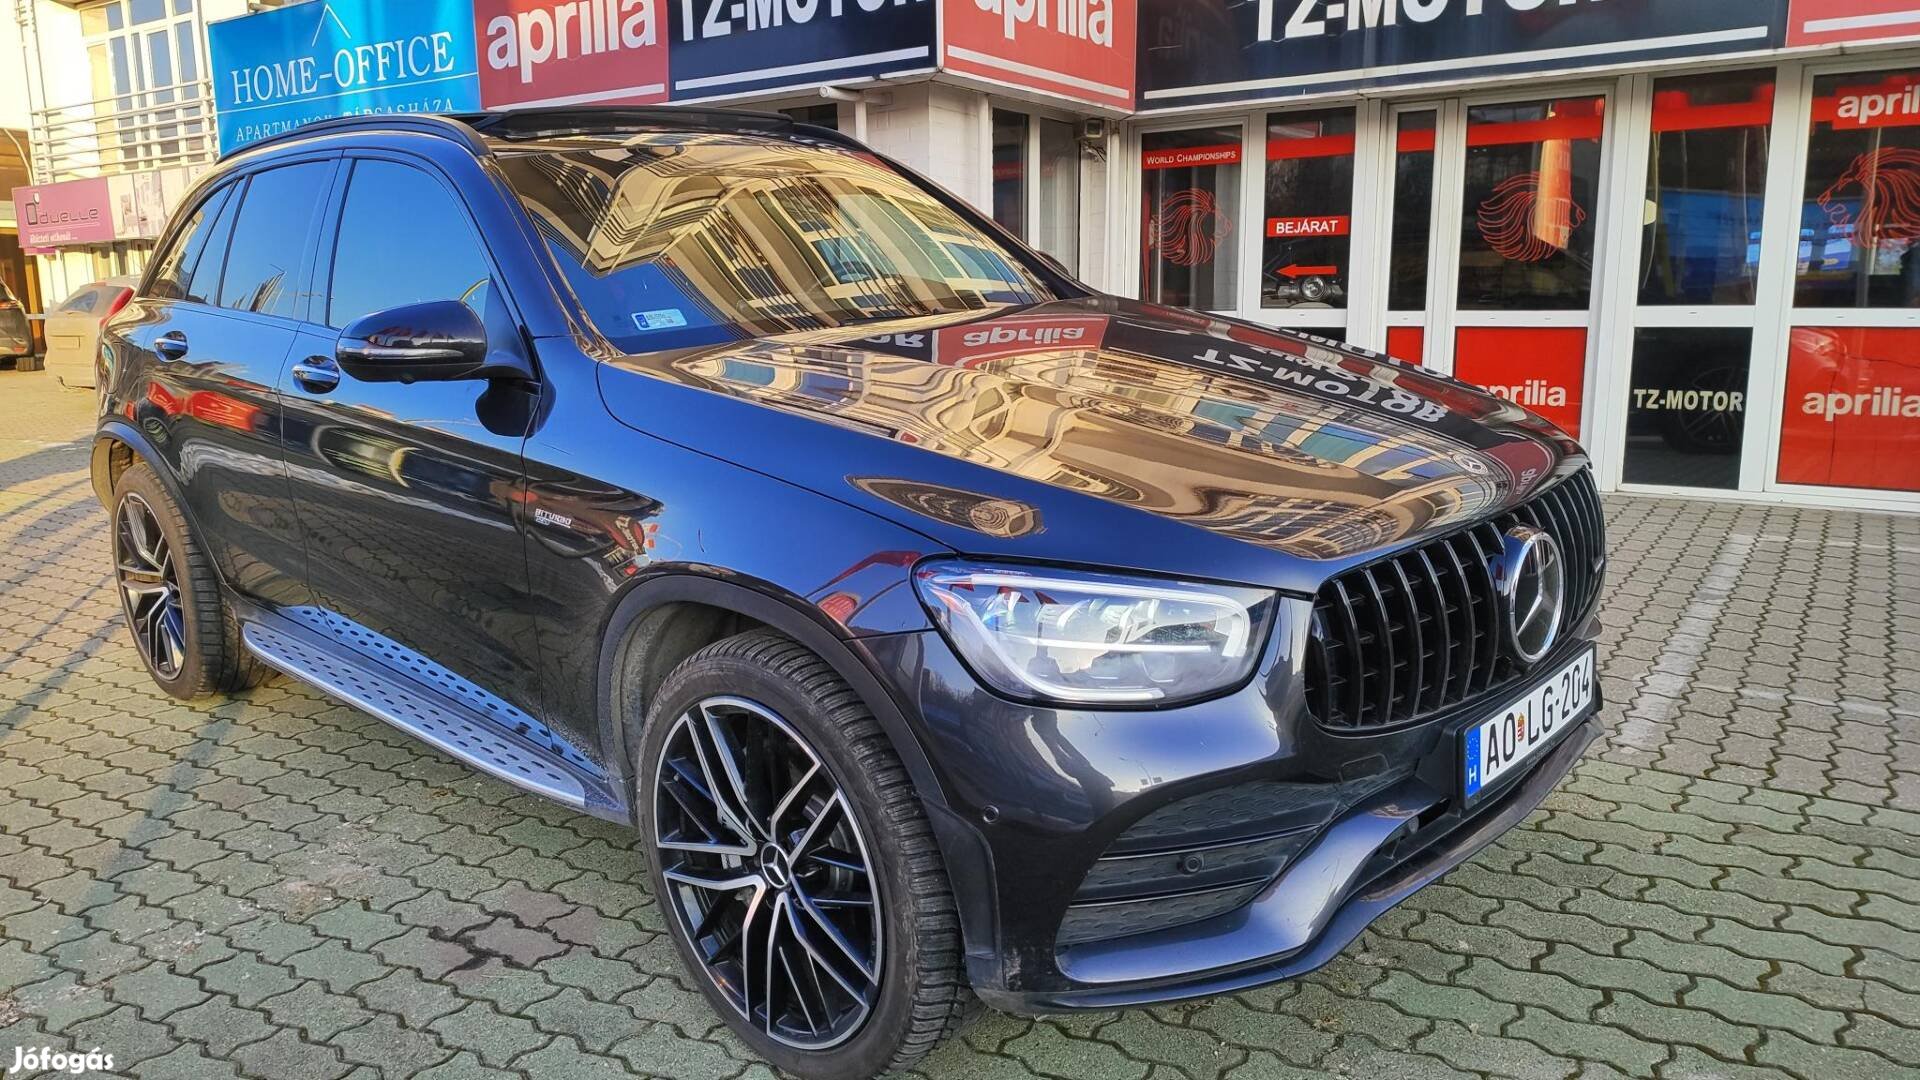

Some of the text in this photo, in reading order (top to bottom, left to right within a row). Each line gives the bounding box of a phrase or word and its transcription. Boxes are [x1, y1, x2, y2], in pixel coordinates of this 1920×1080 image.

[682, 0, 926, 41] TZ-MO
[1247, 0, 1606, 42] TZ-MO
[487, 0, 656, 83] aprilia
[231, 32, 455, 104] HOME-OFFICE
[1276, 219, 1339, 234] BEJÁRAT
[1475, 379, 1566, 407] rilia
[1633, 388, 1743, 412] TZ-MOTOR
[1801, 387, 1920, 422] aprilia
[1468, 765, 1477, 785] H
